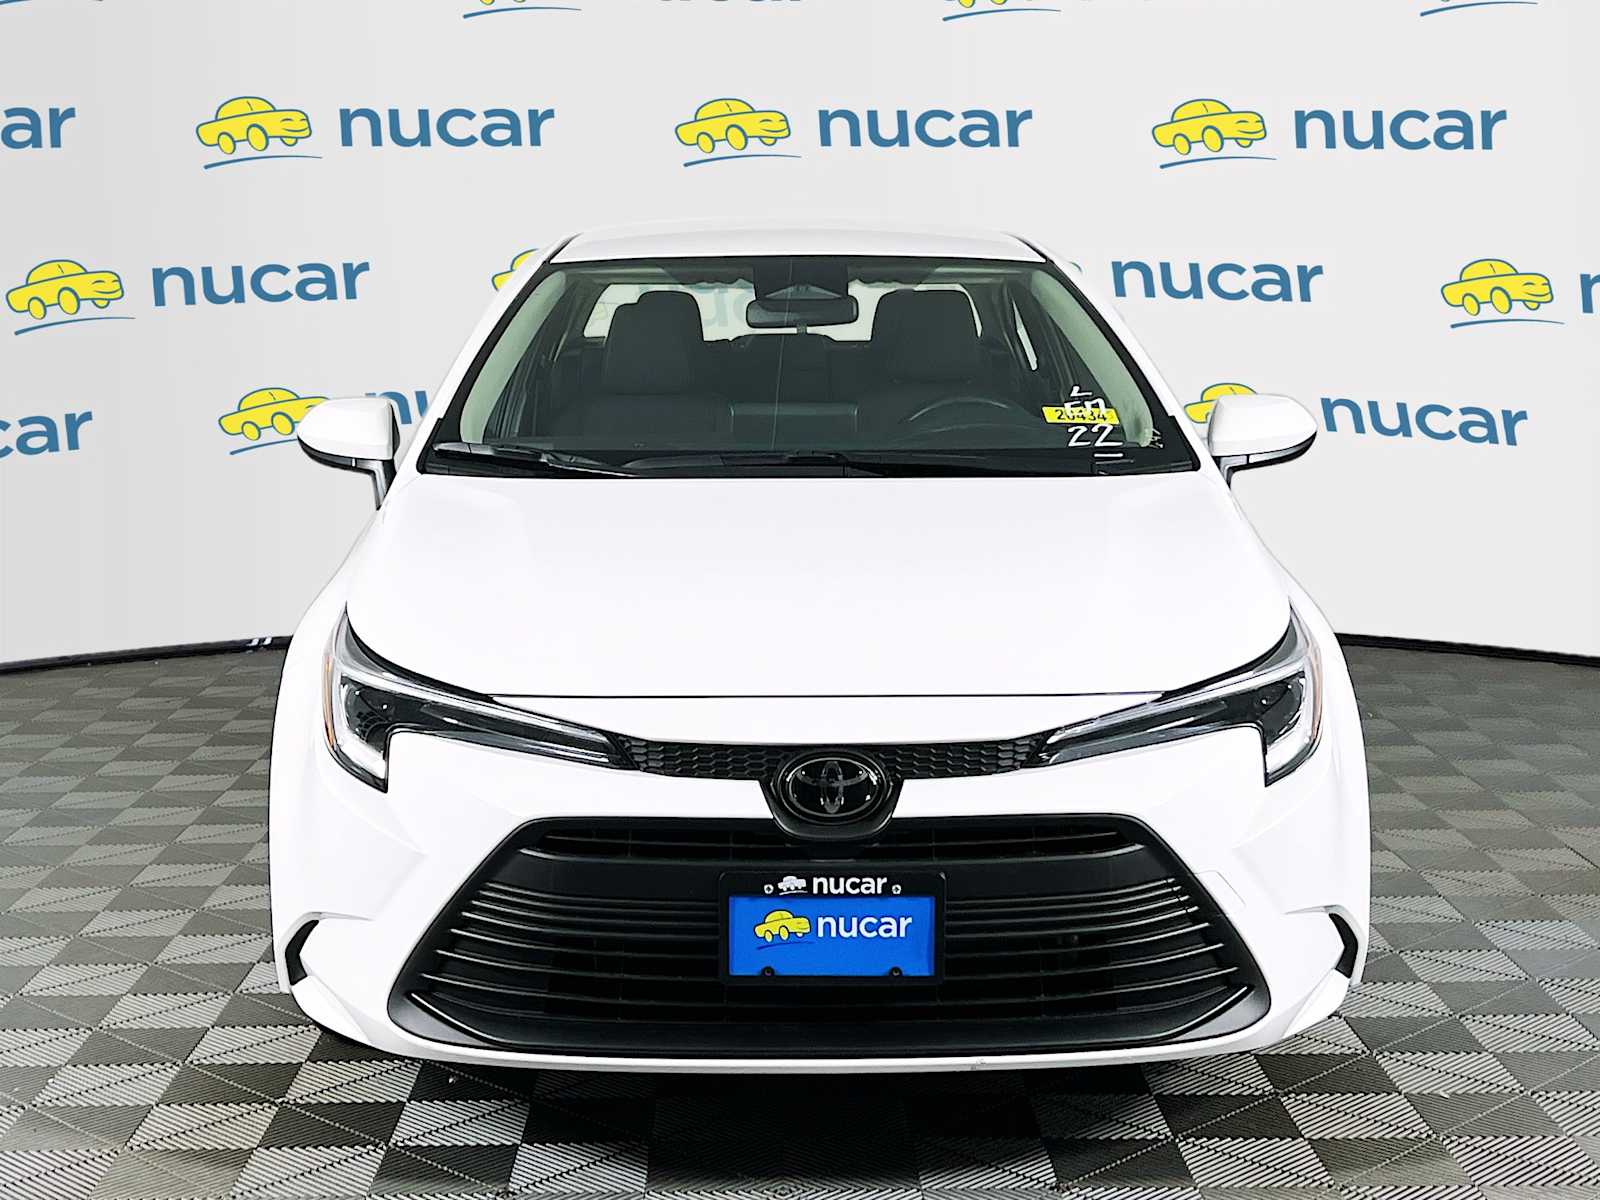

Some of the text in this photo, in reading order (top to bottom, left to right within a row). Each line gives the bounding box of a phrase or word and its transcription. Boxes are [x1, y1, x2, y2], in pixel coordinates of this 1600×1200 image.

[339, 108, 555, 147] nucar
[818, 109, 1033, 148] nucar
[1294, 110, 1507, 150] nucar
[152, 261, 370, 307] nucar
[1111, 260, 1323, 302] nucar
[1067, 424, 1124, 447] 22
[1321, 397, 1528, 446] nucar
[812, 876, 888, 895] nucar
[817, 914, 913, 939] nucar
